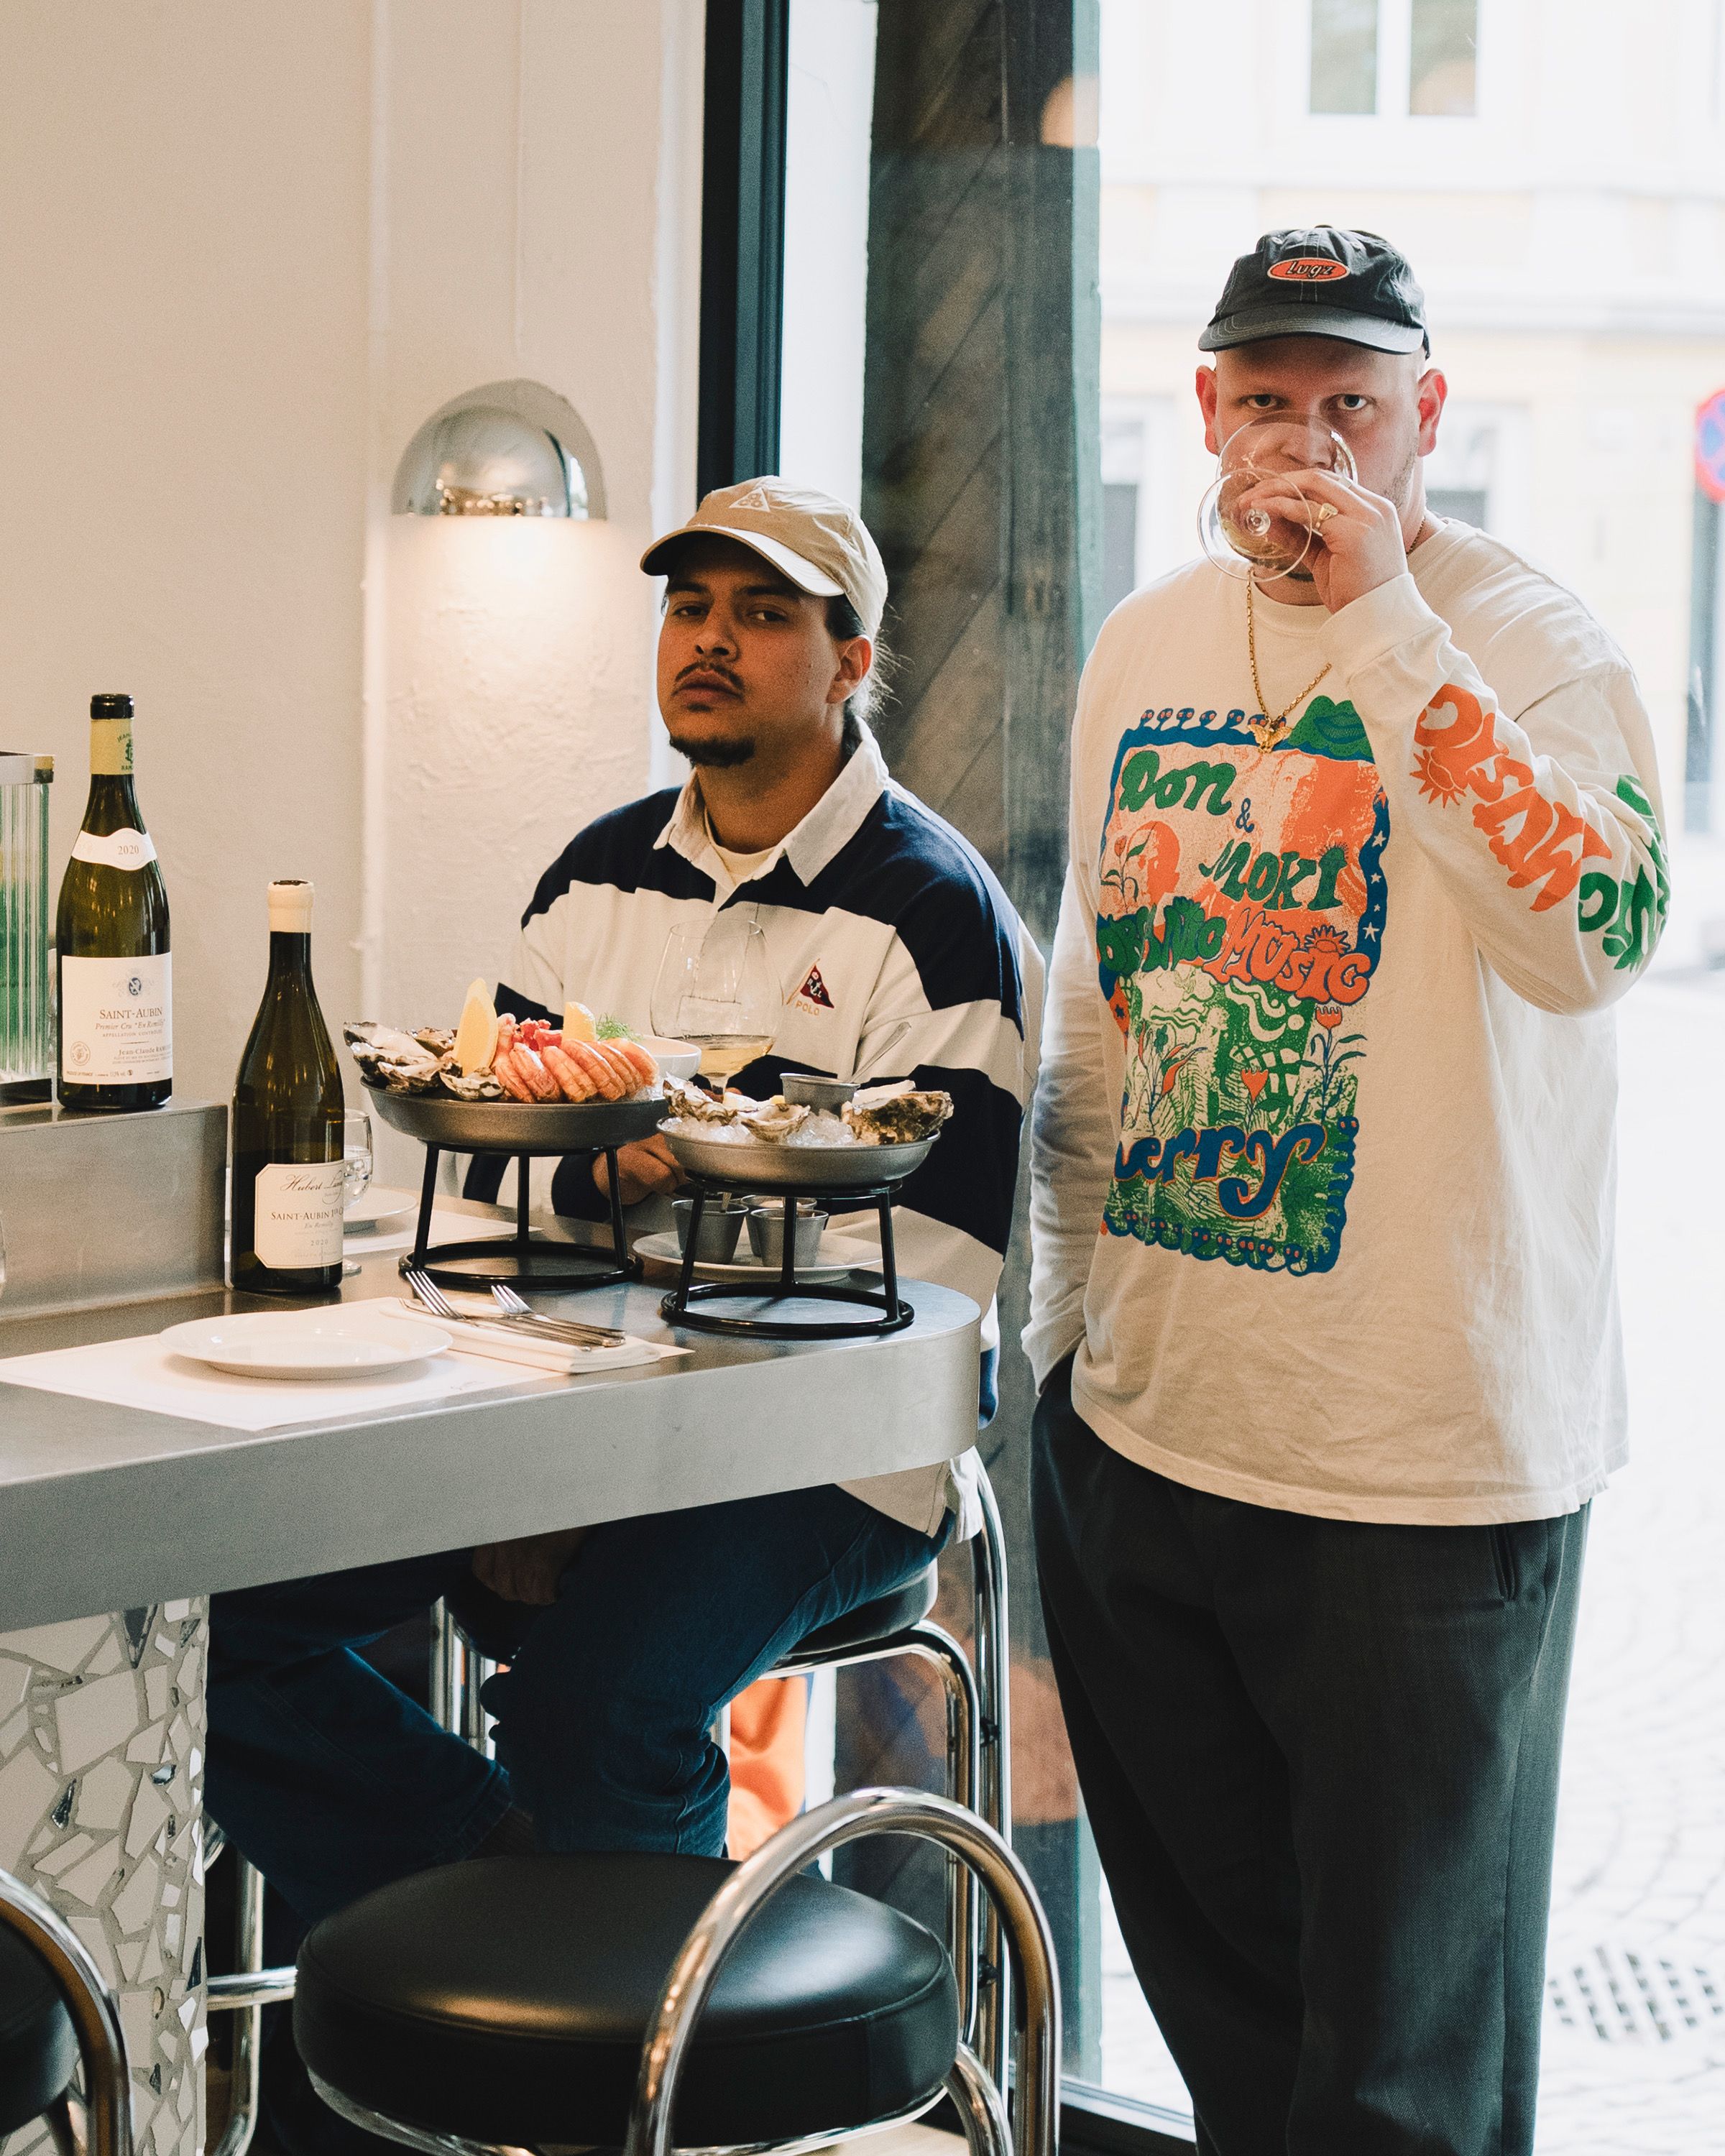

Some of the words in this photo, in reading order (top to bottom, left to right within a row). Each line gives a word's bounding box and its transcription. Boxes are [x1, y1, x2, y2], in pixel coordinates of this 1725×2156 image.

[1286, 259, 1336, 278] Lugz
[1118, 750, 1236, 816] Don
[1413, 683, 1613, 913] MUSIC
[1235, 797, 1255, 833] &
[117, 845, 139, 854] 2020
[1202, 907, 1371, 1005] MUSIC
[99, 1007, 162, 1019] SAINT-AUBIN
[795, 1000, 820, 1016] POLO
[1113, 1121, 1328, 1220] erry
[280, 1174, 323, 1191] Hubert
[271, 1210, 330, 1220] SAINT-AUBIN
